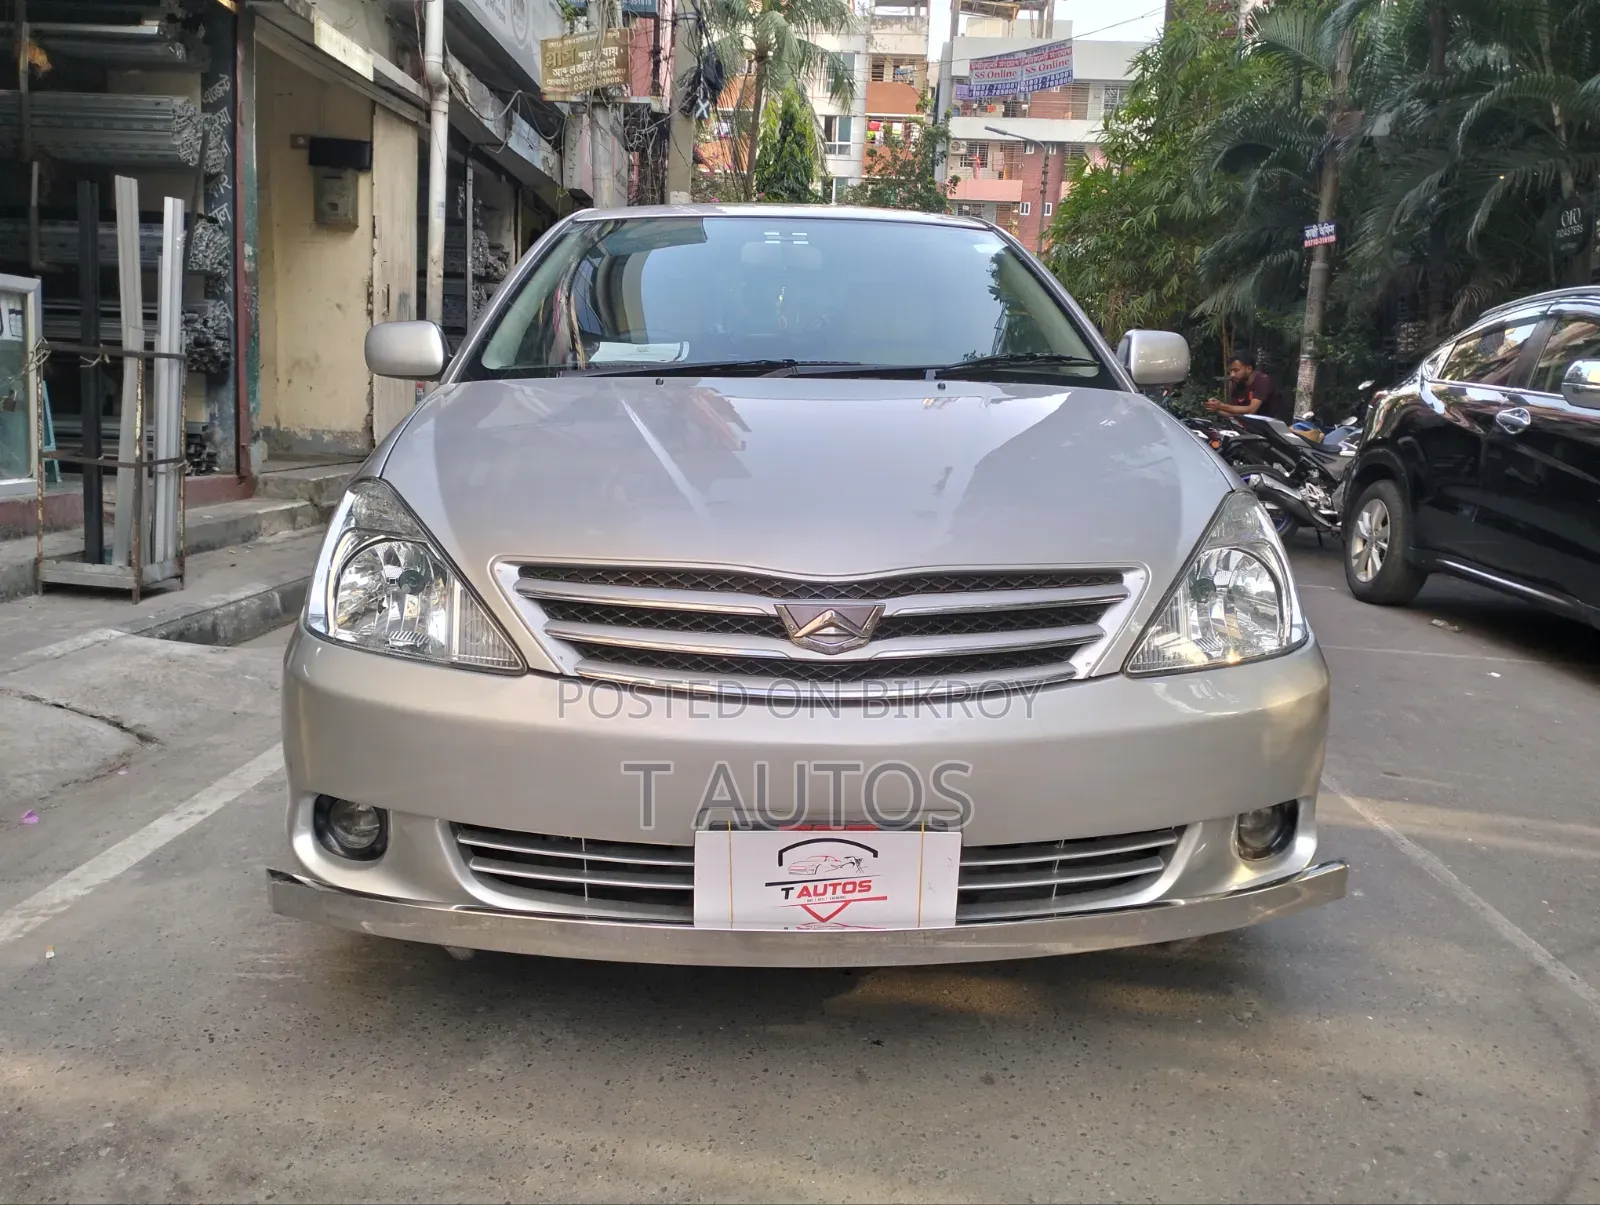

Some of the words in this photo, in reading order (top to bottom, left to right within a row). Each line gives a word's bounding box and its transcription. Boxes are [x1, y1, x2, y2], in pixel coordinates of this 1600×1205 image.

[974, 71, 985, 80] SS
[987, 70, 1017, 79] Online
[1025, 66, 1036, 75] SS
[1038, 59, 1070, 72] Online
[781, 886, 794, 900] T
[796, 879, 872, 899] AUTOS
